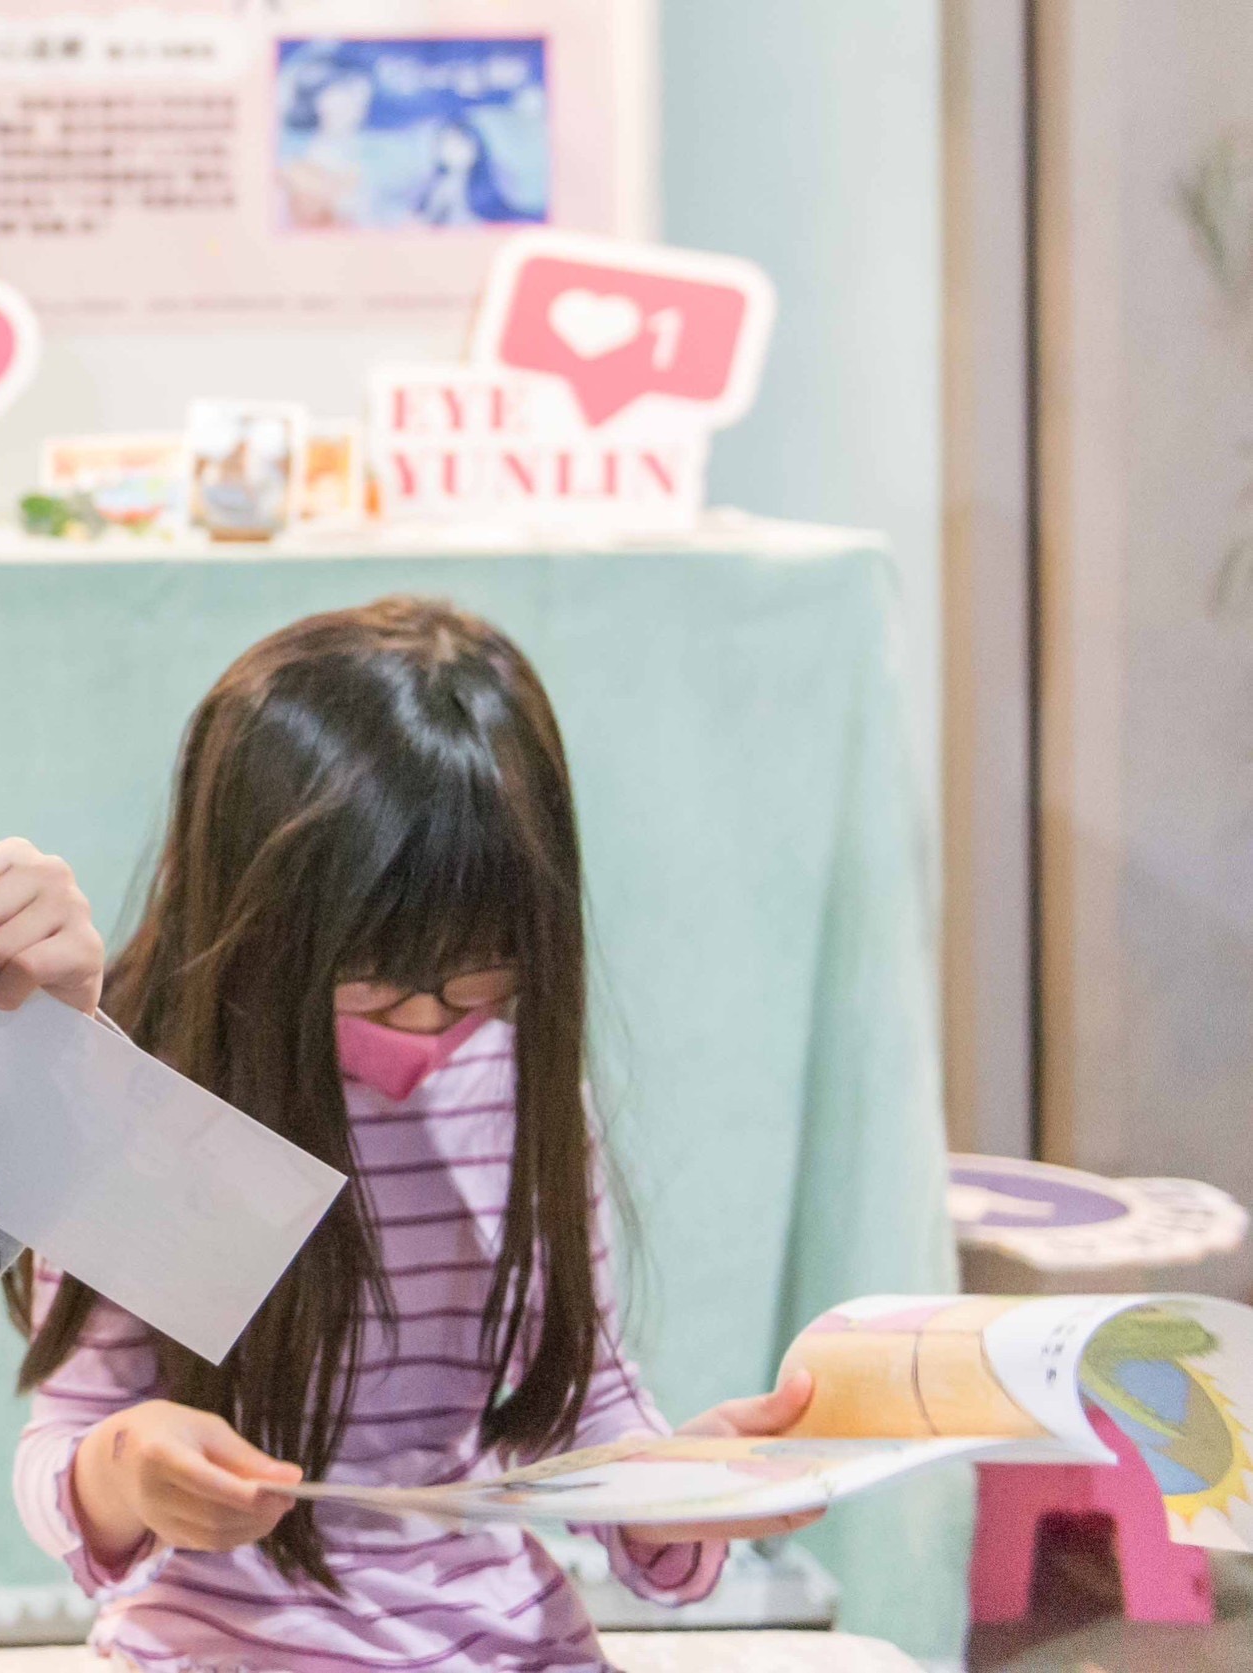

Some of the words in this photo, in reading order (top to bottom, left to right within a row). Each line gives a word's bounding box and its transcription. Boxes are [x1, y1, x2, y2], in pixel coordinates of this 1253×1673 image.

[646, 307, 683, 373] 1
[388, 383, 531, 433] EYE
[389, 446, 685, 497] YUNLIN
